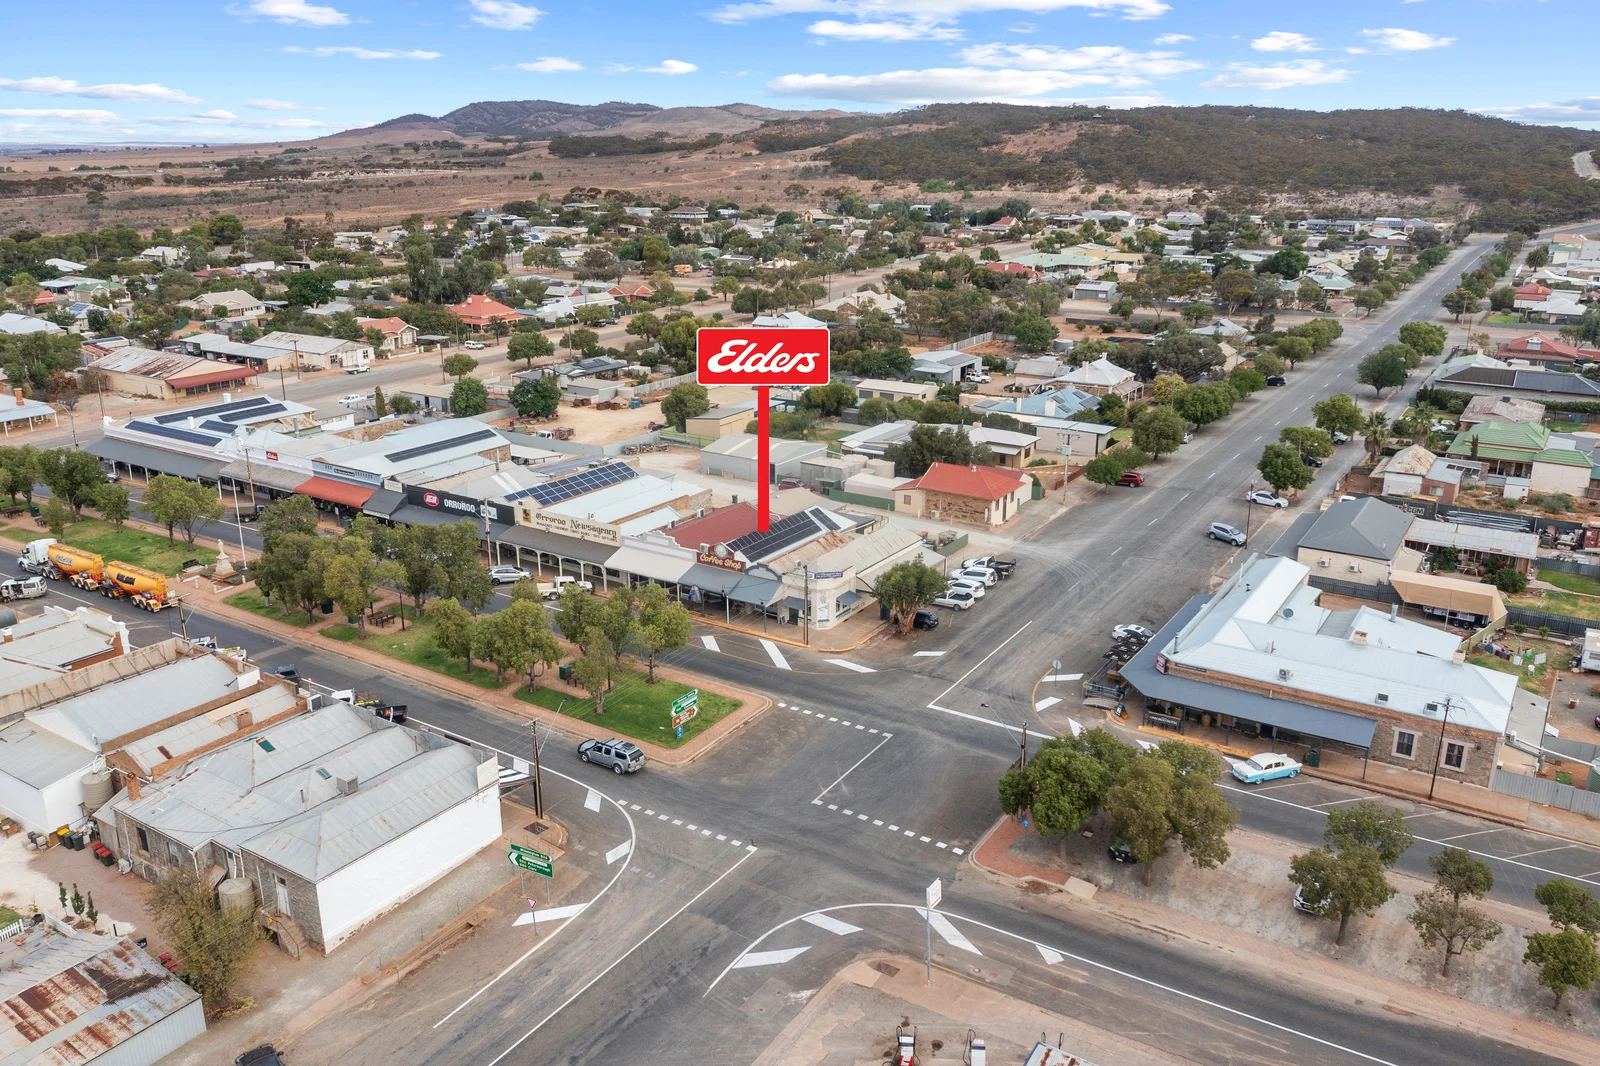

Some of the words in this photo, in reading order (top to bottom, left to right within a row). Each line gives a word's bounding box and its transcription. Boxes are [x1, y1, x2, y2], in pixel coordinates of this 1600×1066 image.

[426, 494, 437, 504] IGA
[443, 498, 476, 513] ORROROO
[535, 512, 567, 526] Orroroo
[570, 519, 618, 539] Newsagency
[700, 553, 724, 566] Coffee
[724, 558, 742, 570] Shop
